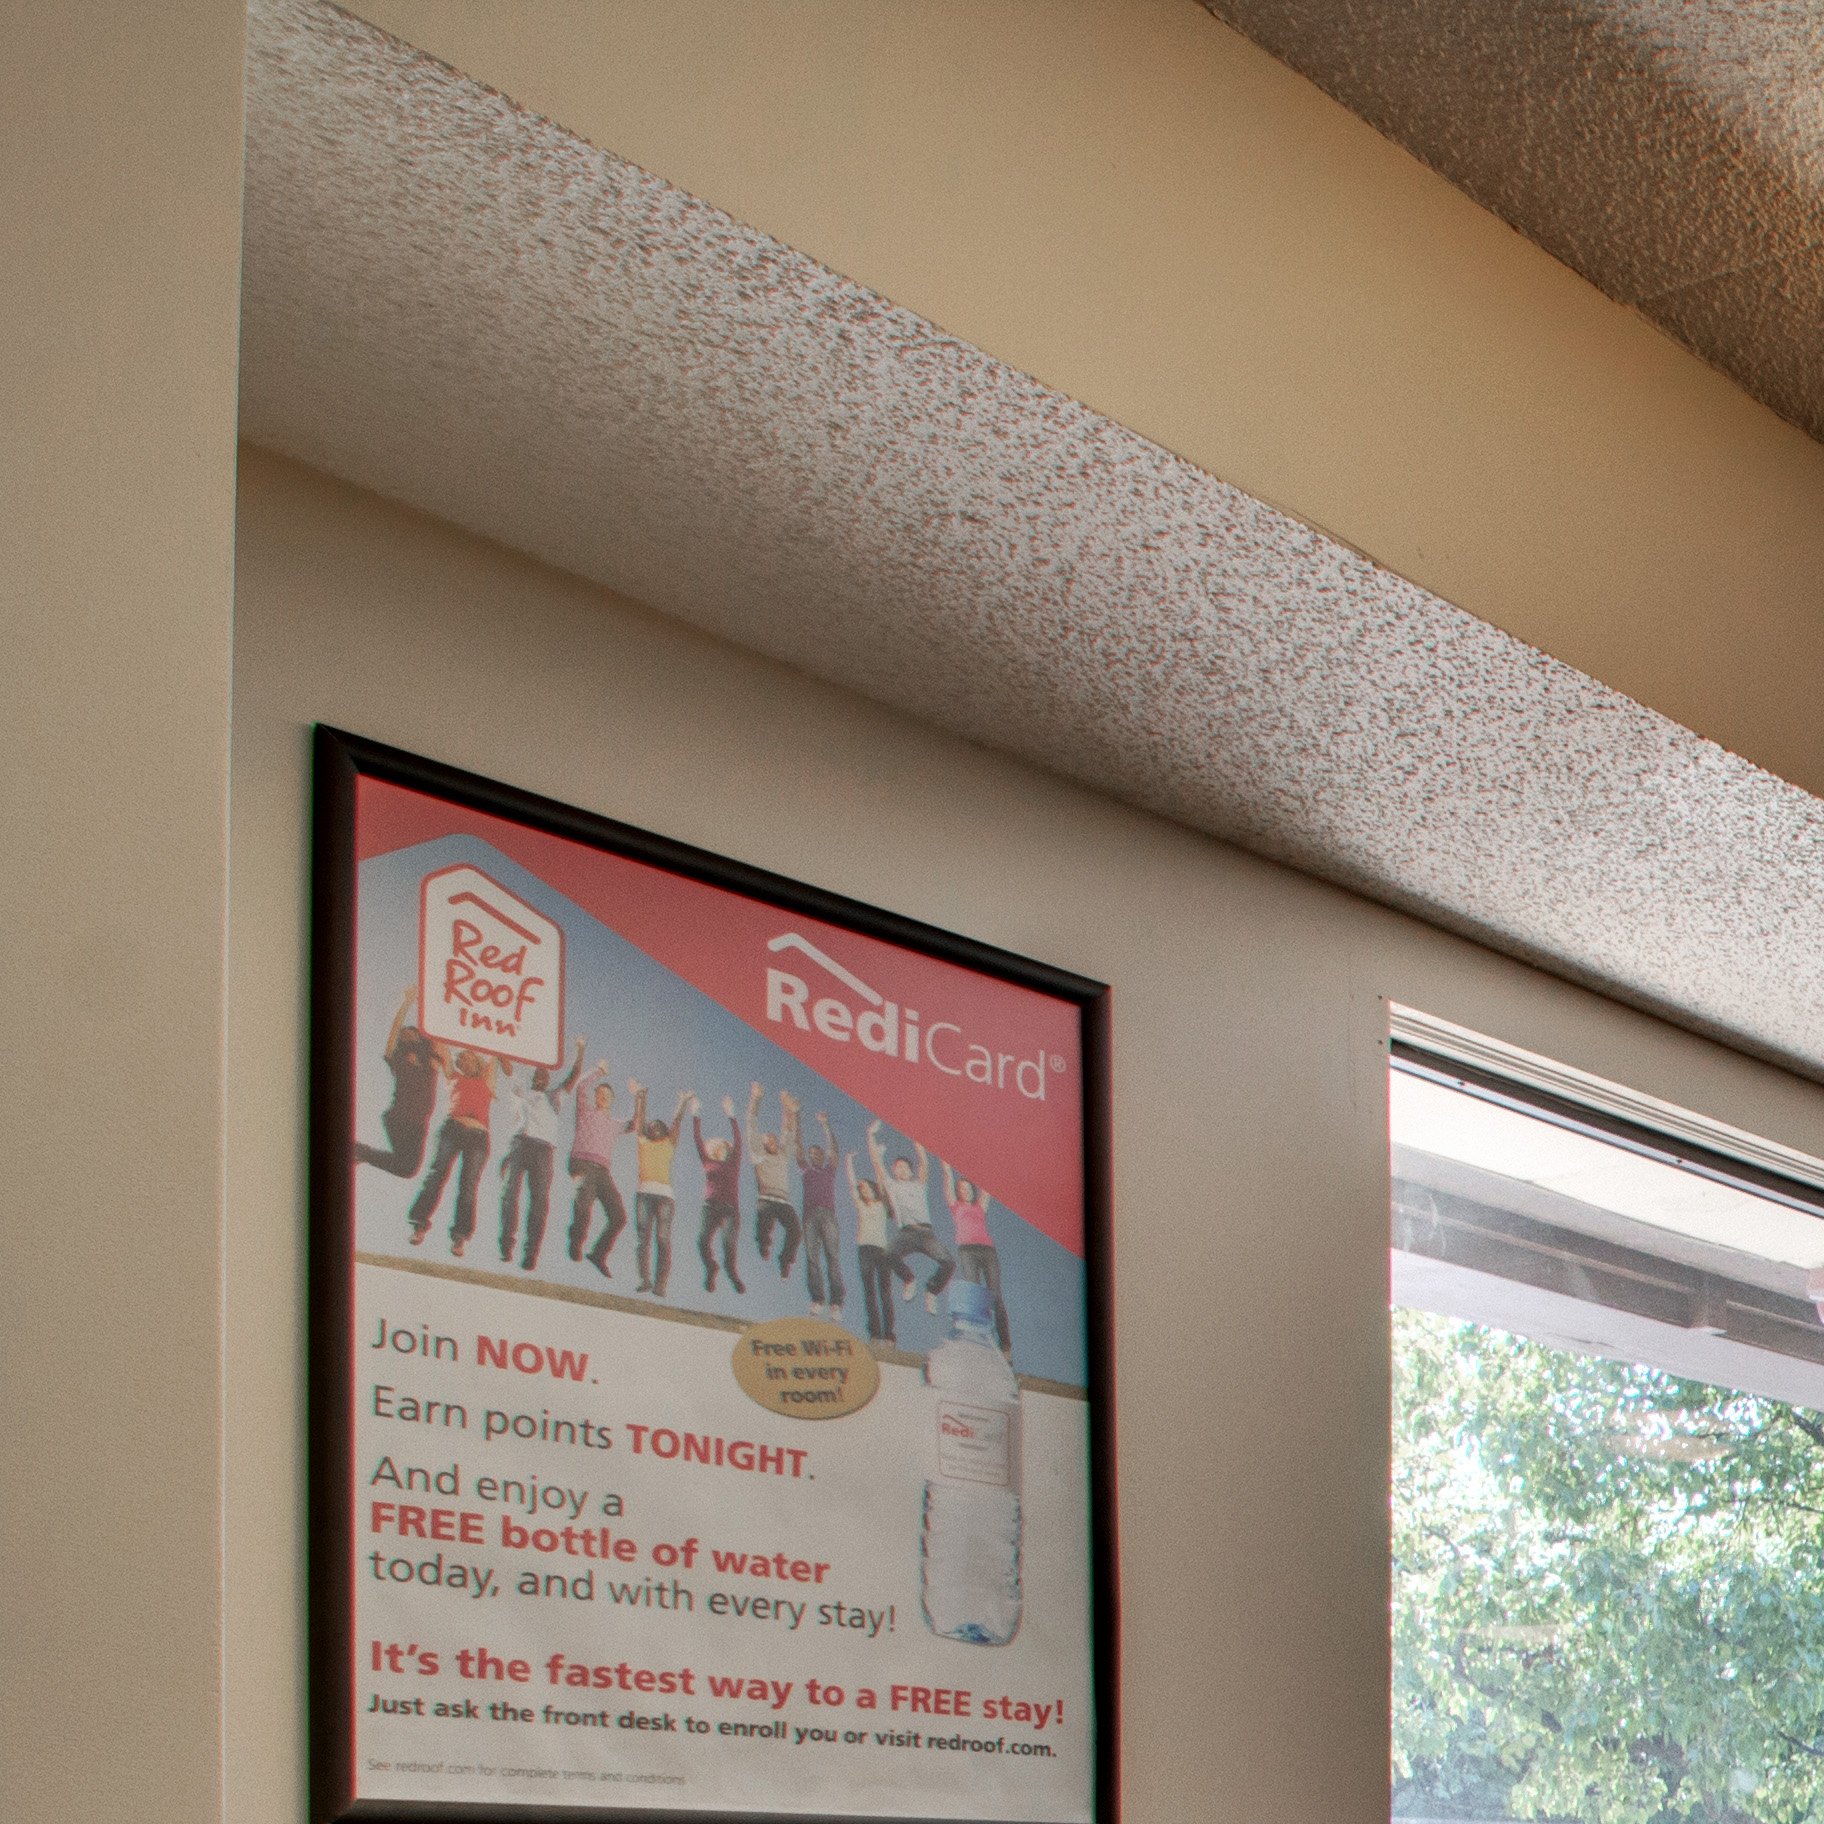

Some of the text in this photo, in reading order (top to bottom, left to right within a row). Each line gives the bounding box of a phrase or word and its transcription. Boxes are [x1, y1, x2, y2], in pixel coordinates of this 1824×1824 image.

[451, 918, 528, 976] Red
[444, 959, 545, 1022] Roof
[371, 1318, 458, 1362] Join
[752, 1339, 853, 1357] Free Wi-Fi
[764, 1364, 849, 1383] in every
[780, 1387, 844, 1405] room!
[372, 1385, 468, 1430] Earn
[485, 1409, 613, 1450] points
[370, 1456, 623, 1519] And enjoy a
[371, 1502, 831, 1585] FREE bottle of water
[370, 1550, 896, 1636] today, and with every stay!
[455, 1647, 531, 1684] the
[546, 1653, 695, 1696] fastest
[708, 1672, 792, 1708] way
[805, 1676, 844, 1708] to
[856, 1687, 878, 1711] a
[890, 1685, 971, 1717] FREE
[982, 1691, 1065, 1729] stay!
[368, 1694, 1057, 1759] Just ask the front desk to enroll you or visit redroof.com.
